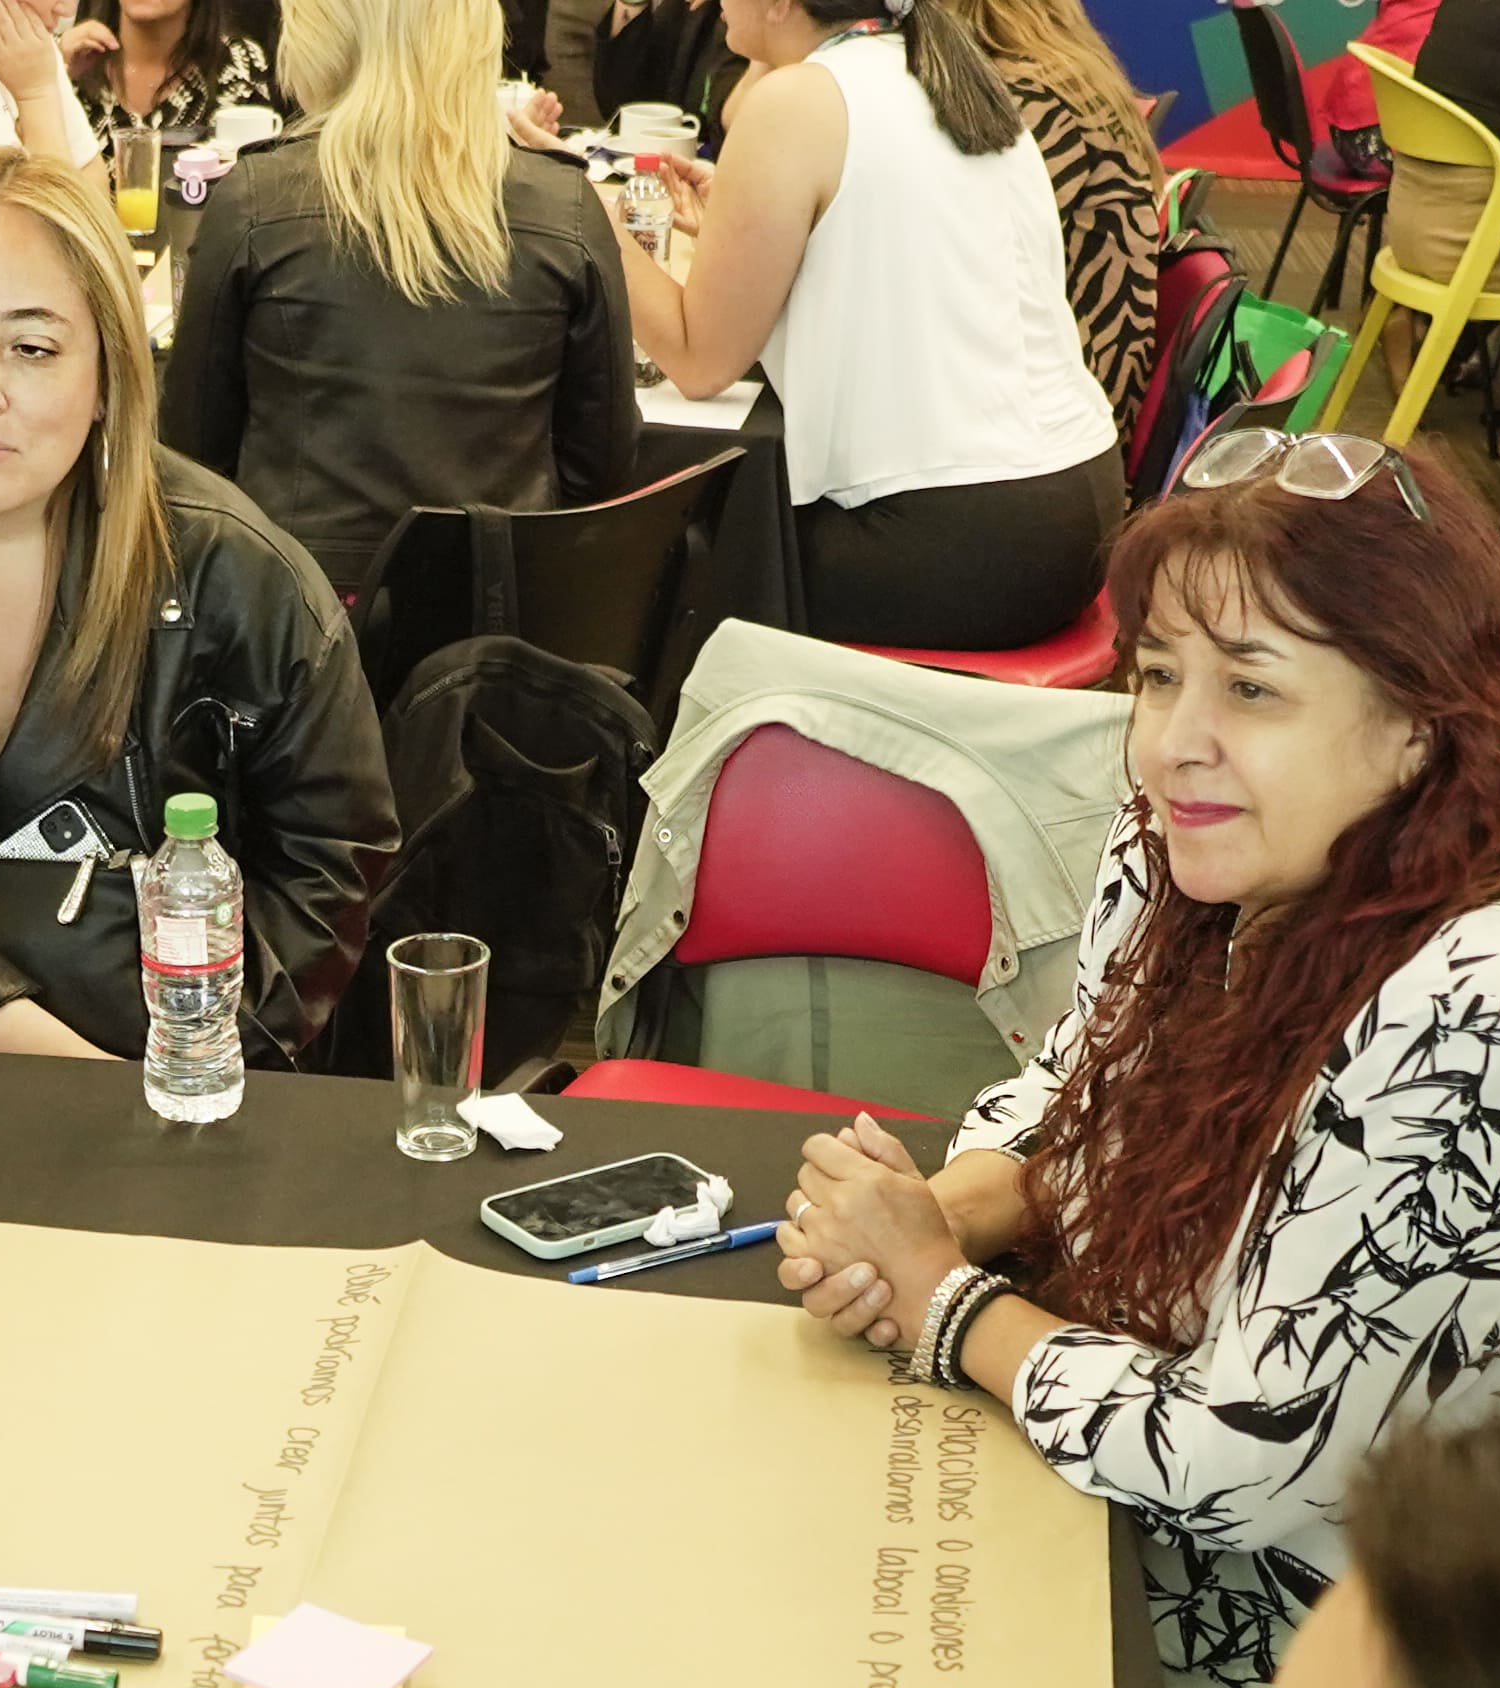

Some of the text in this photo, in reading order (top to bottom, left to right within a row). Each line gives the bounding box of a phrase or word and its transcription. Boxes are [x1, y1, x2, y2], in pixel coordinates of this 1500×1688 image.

[300, 1315, 362, 1406] podríamos
[275, 1426, 321, 1476] crear
[242, 1482, 295, 1549] juntas
[213, 1565, 263, 1610] para
[872, 1547, 919, 1615] laboral
[930, 1564, 976, 1671] condiciones
